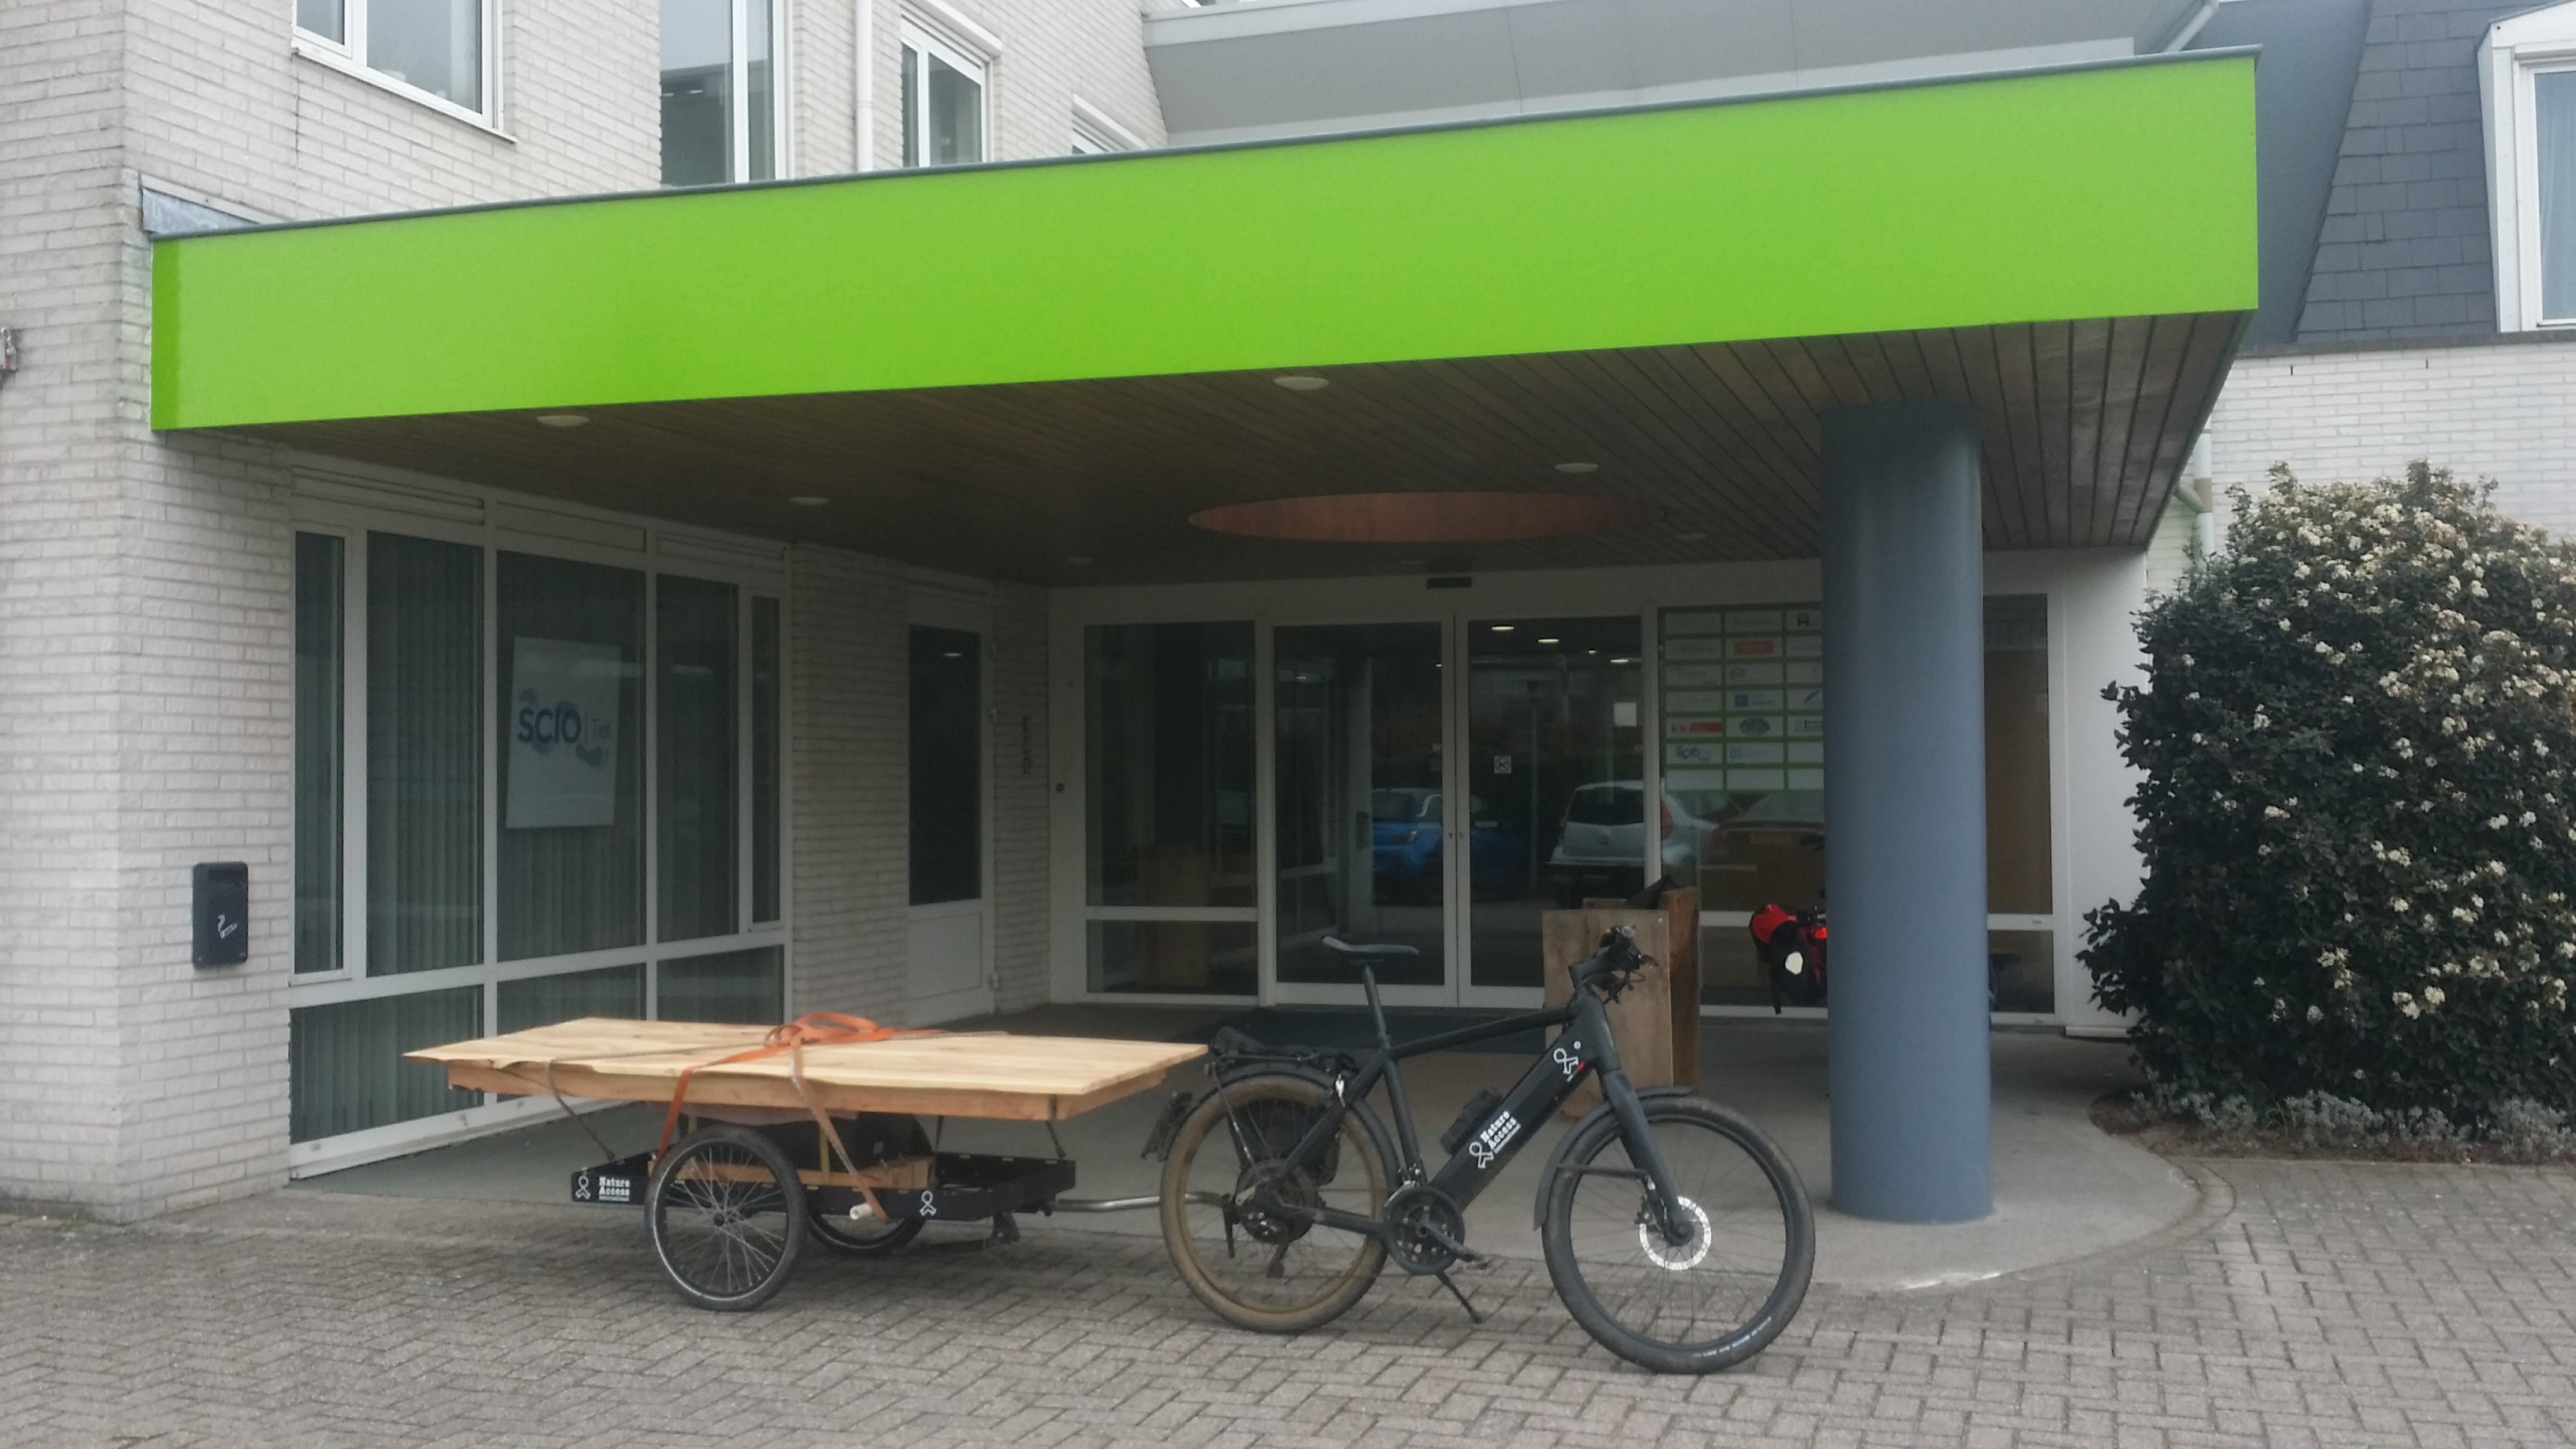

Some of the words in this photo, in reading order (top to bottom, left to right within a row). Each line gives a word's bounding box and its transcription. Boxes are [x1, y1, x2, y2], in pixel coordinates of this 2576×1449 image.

[1481, 1110, 1511, 1143] Nature
[1488, 1117, 1517, 1150] Access
[598, 1177, 631, 1187] Nature
[598, 1186, 630, 1196] Access
